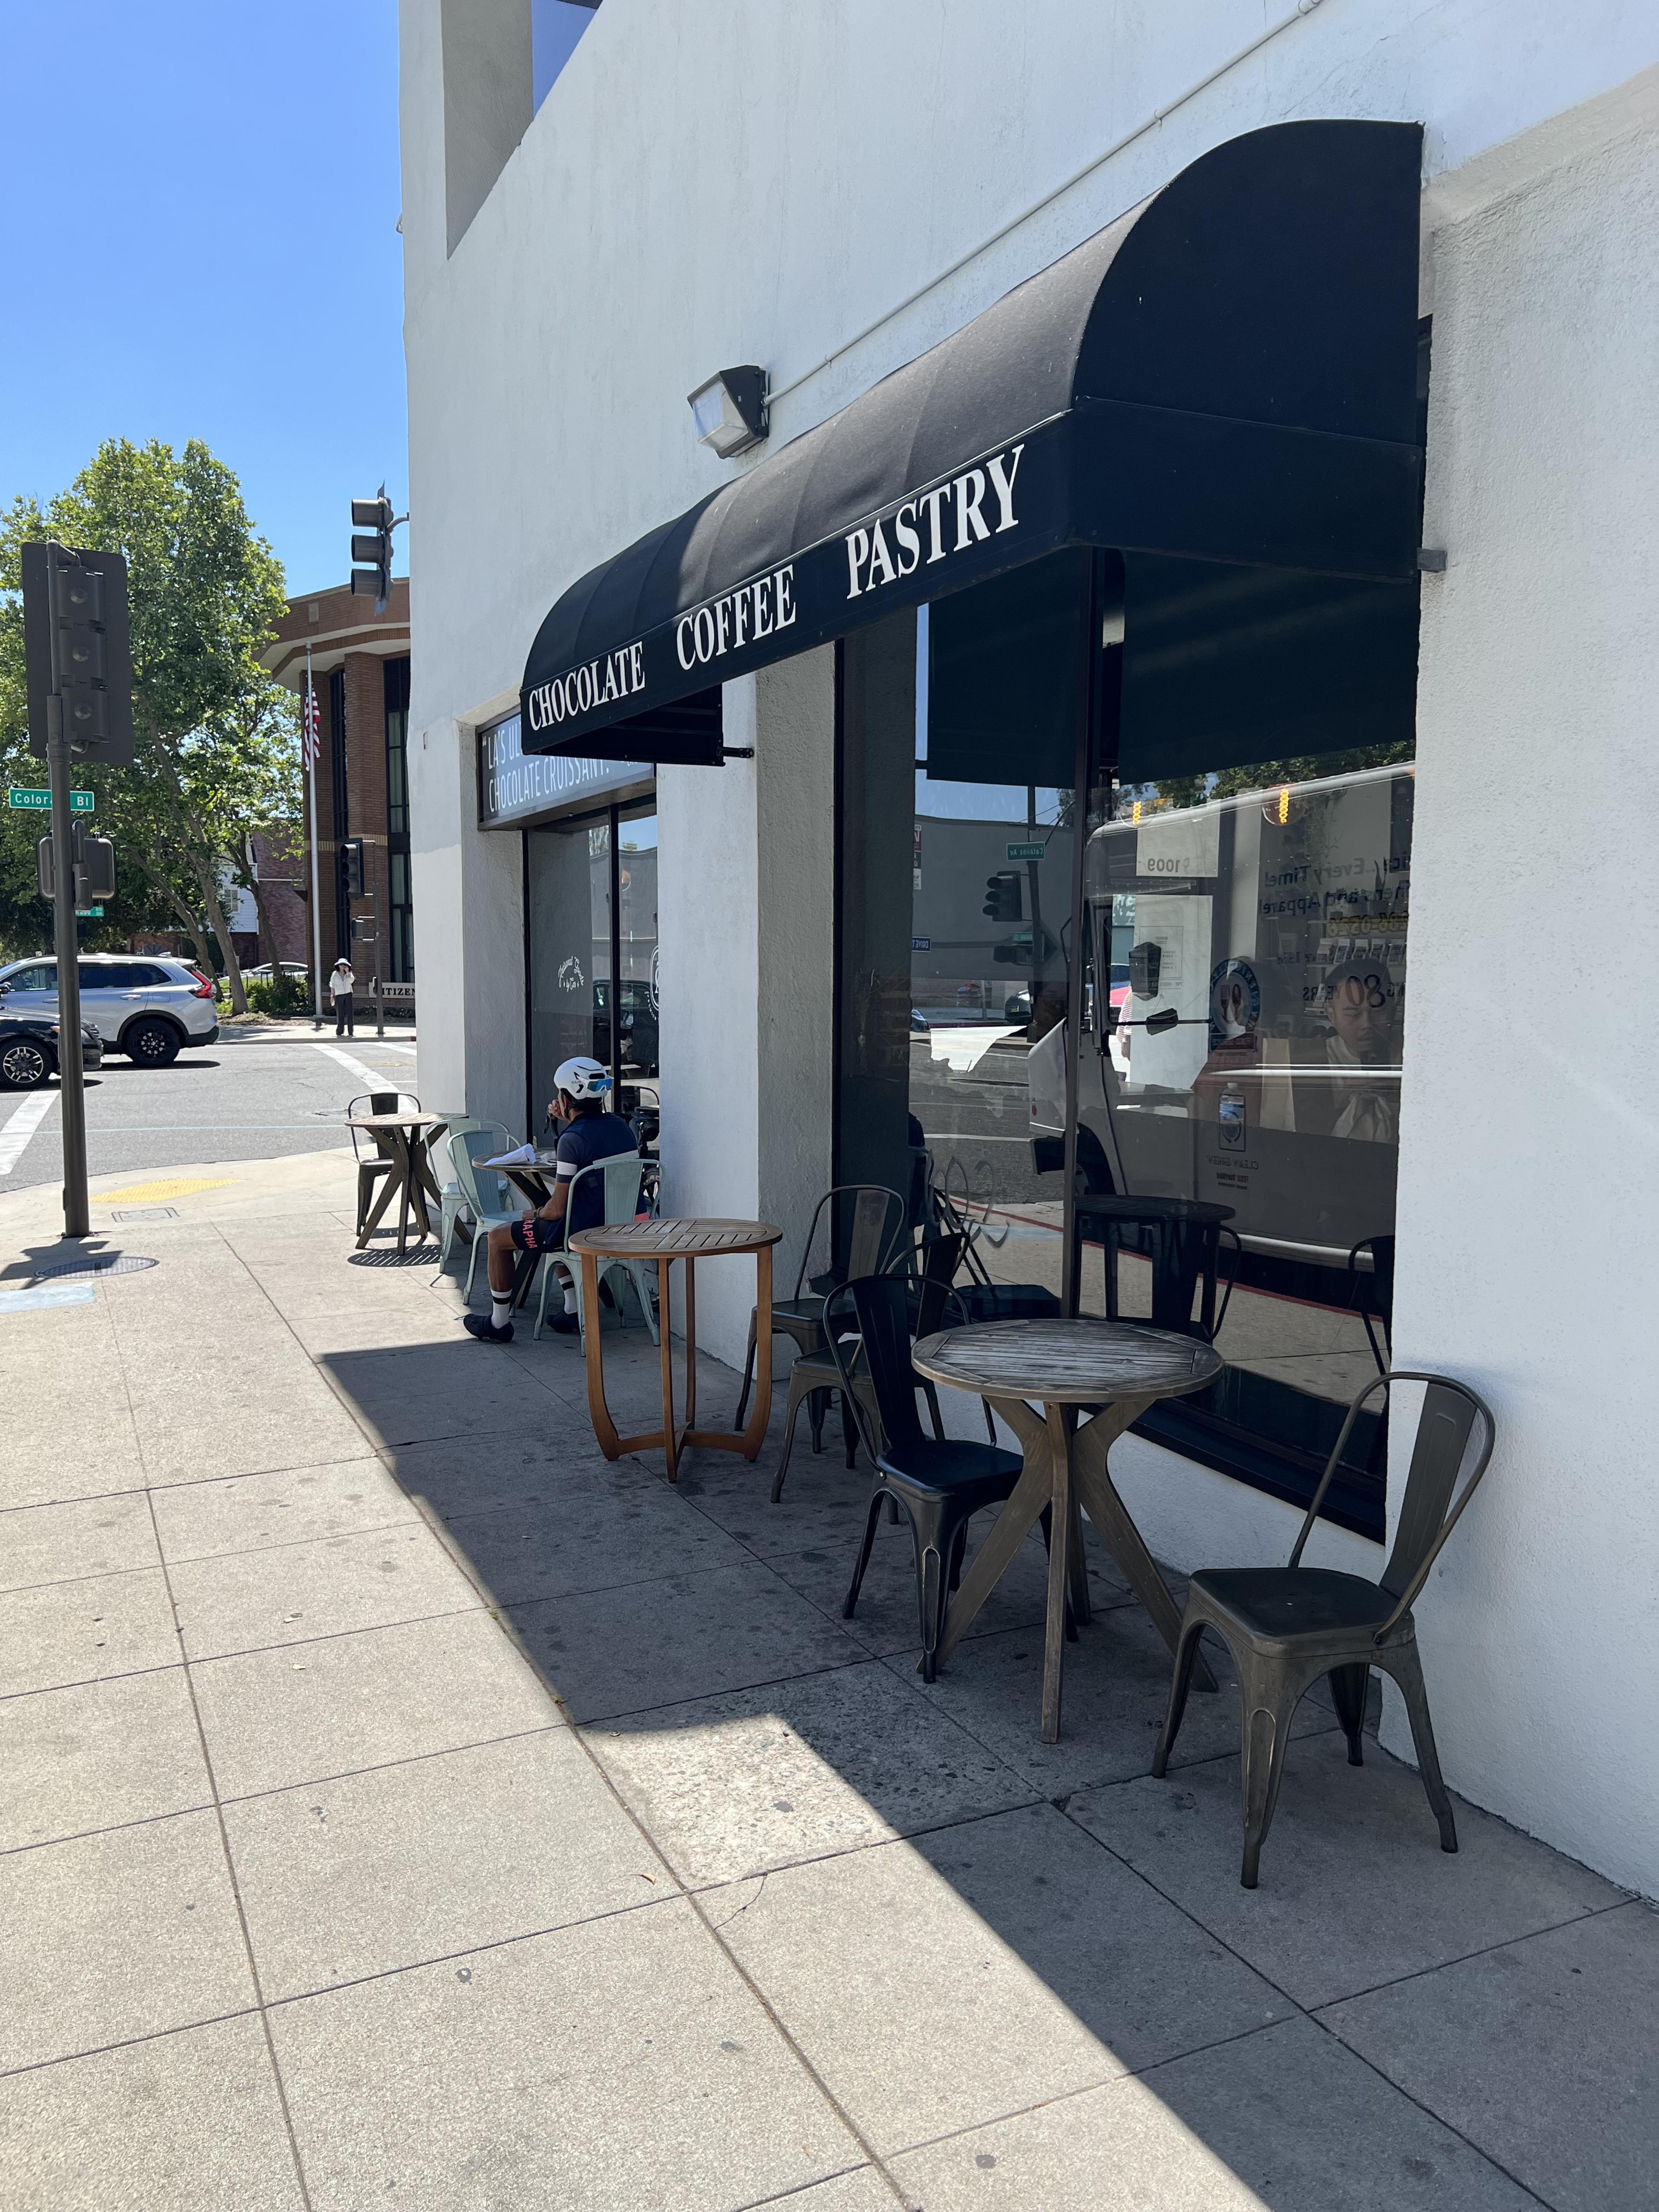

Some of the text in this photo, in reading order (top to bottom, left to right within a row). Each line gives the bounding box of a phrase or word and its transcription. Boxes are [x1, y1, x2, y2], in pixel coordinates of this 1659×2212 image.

[528, 444, 1024, 731] CHOCOLATE COFFEE PASTRY
[77, 796, 89, 806] Bl
[489, 760, 541, 813] CHOCOLATE
[522, 1218, 538, 1249] RAPHA
